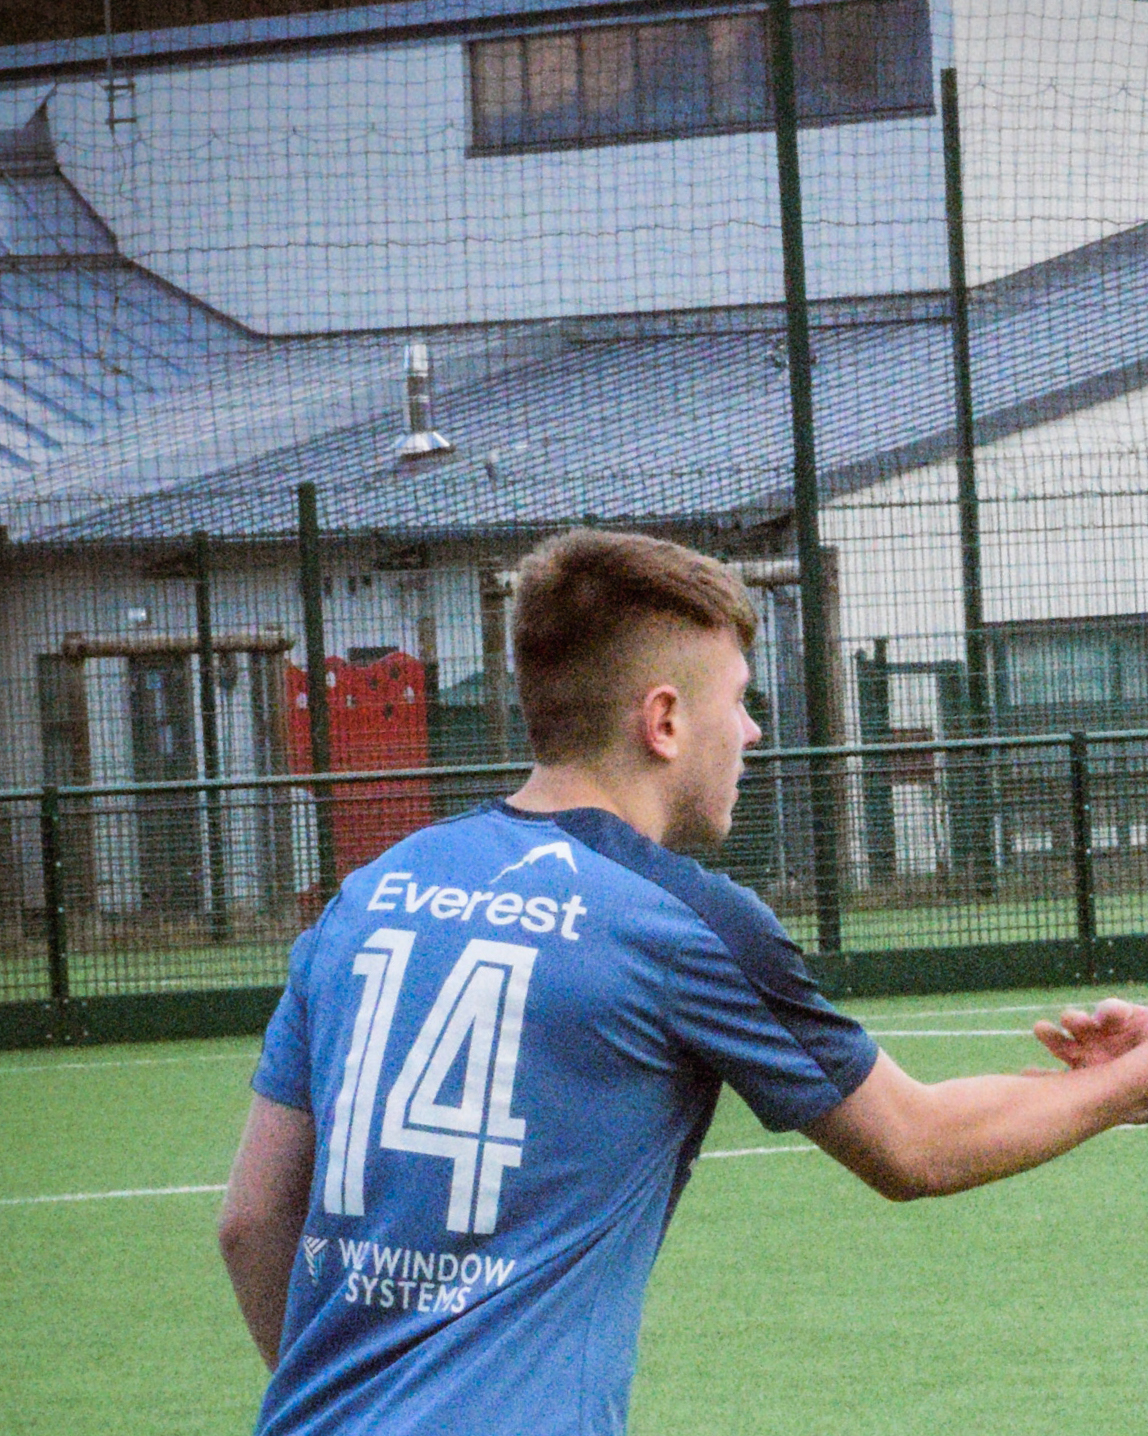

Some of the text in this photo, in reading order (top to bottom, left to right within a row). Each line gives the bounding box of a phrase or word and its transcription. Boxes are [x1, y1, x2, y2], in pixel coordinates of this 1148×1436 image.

[367, 872, 587, 941] Everest
[323, 927, 539, 1235] 14
[345, 1271, 472, 1314] SYSTEMS
[373, 1243, 516, 1287] WINDOW
